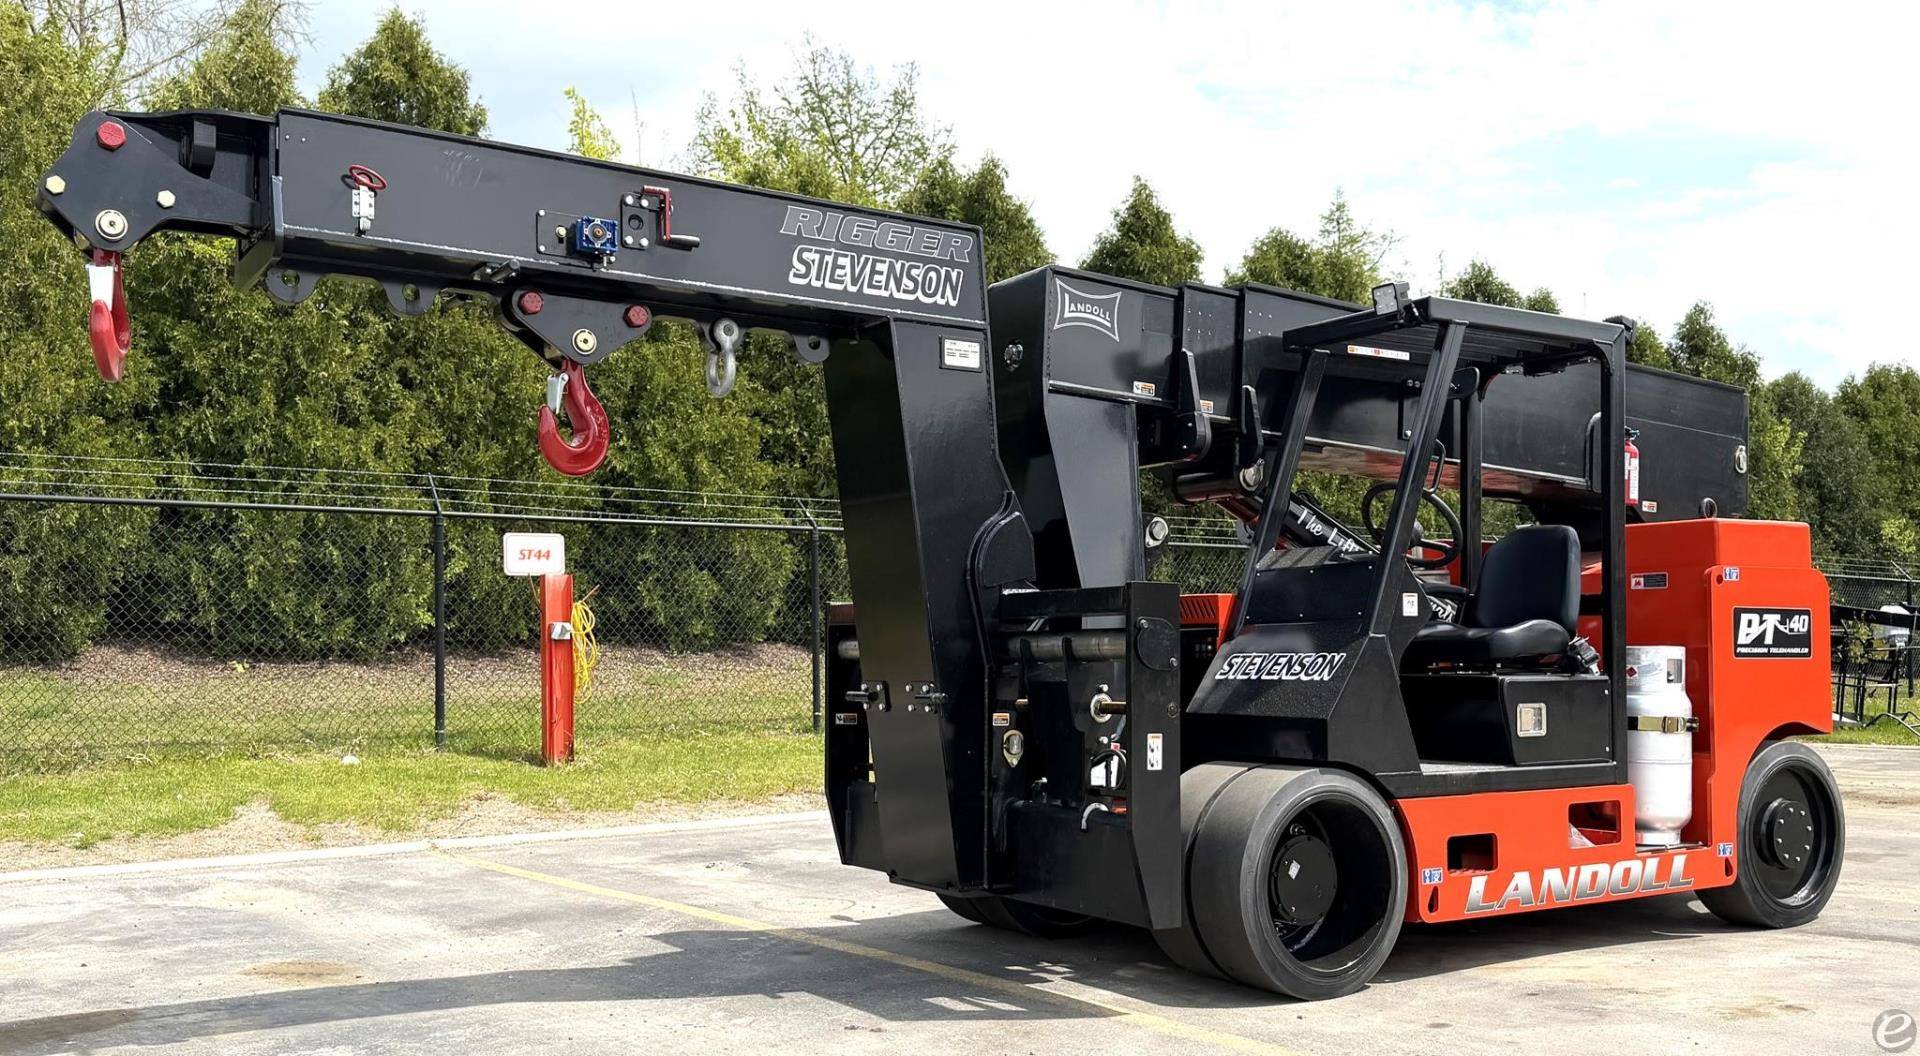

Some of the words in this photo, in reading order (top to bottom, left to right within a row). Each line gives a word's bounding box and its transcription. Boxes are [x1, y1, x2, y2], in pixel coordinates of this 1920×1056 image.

[779, 205, 973, 263] RIGGER
[788, 244, 964, 307] STEVENSON
[1063, 292, 1112, 328] LANDOLL
[1297, 505, 1323, 536] The
[518, 549, 551, 561] ST44
[1215, 652, 1347, 681] STEVENSON
[1736, 646, 1769, 654] PRECISION
[1464, 854, 1695, 914] LANDOLL
